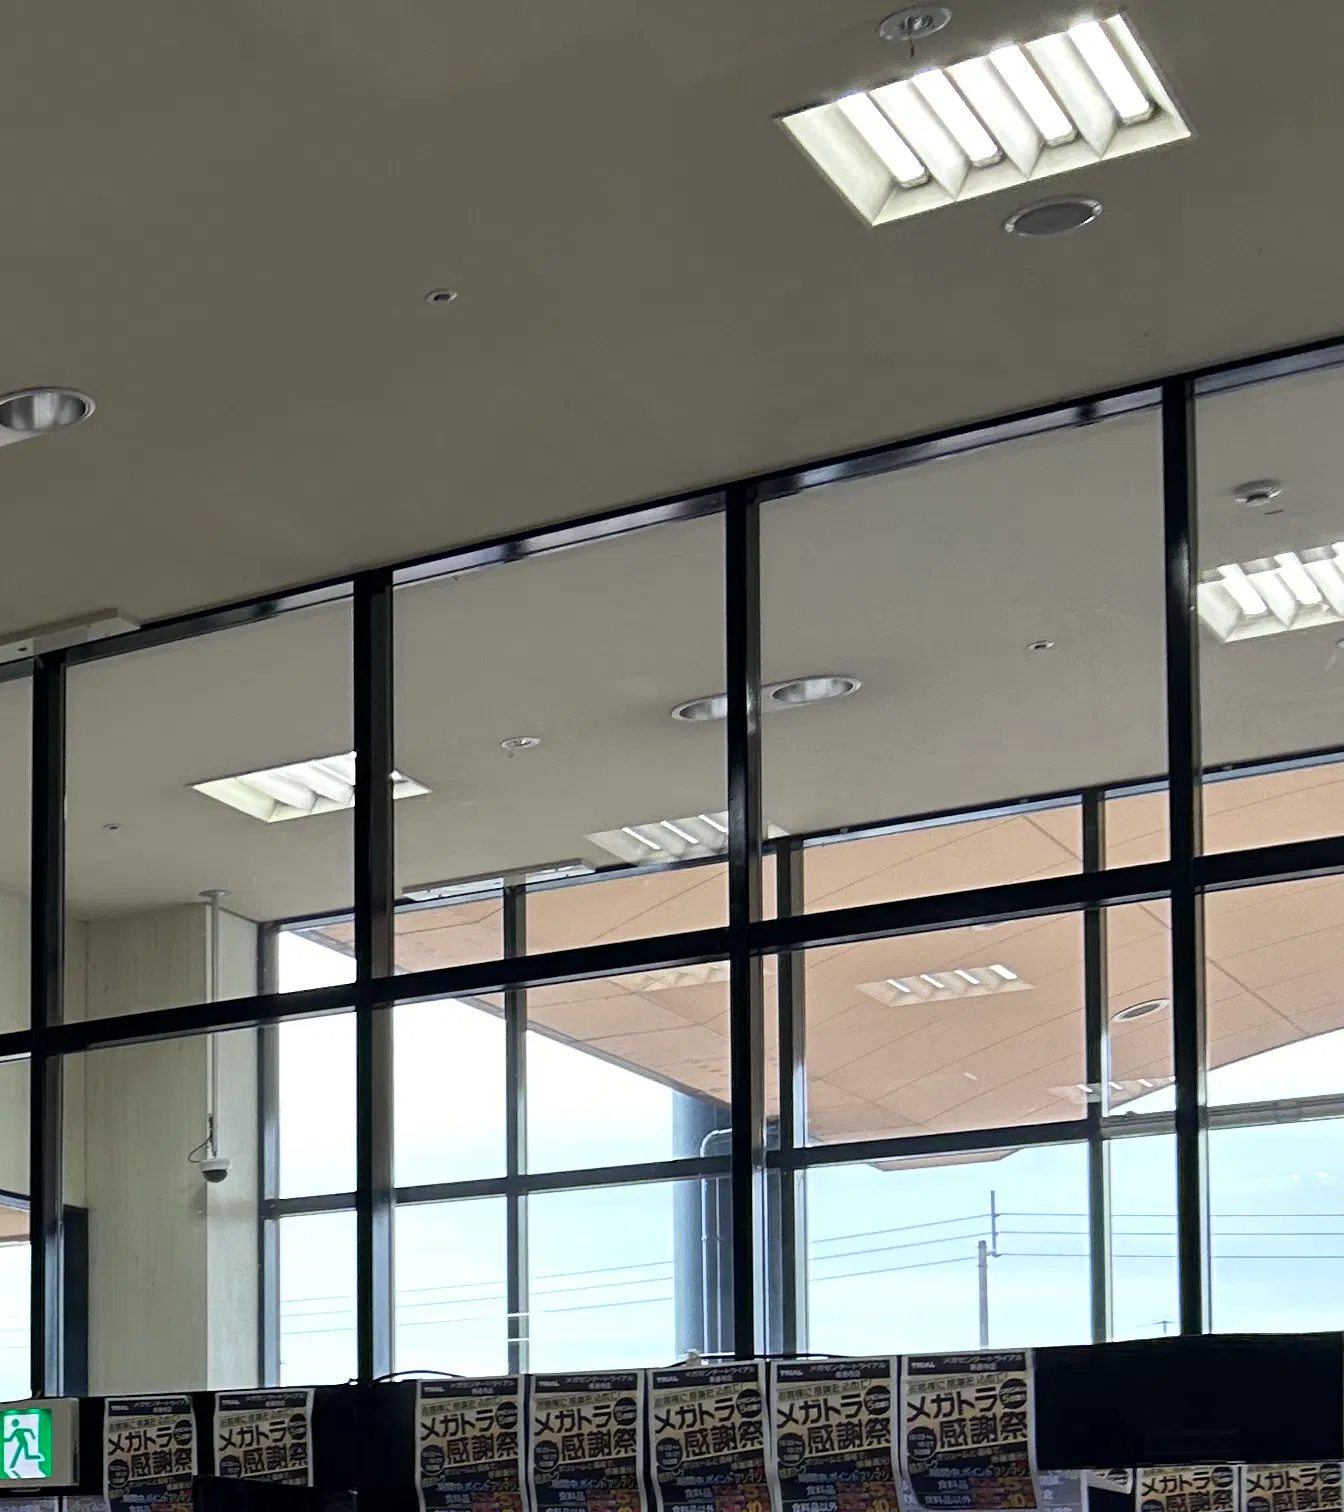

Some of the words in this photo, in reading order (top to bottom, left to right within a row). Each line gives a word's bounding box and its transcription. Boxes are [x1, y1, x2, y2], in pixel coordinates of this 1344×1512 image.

[655, 1397, 735, 1434] メガトラ
[777, 1393, 862, 1428] メガトラ
[907, 1386, 998, 1422] メガトラ
[219, 1420, 287, 1451] メガトラ
[421, 1408, 494, 1441] メガトラ
[534, 1405, 612, 1437] メガトラ
[807, 1417, 891, 1454] 感謝祭
[940, 1411, 1027, 1449] 感謝祭
[108, 1426, 173, 1455] メガトラ
[447, 1432, 518, 1465] 感謝祭
[562, 1428, 637, 1461] 感謝祭
[684, 1421, 764, 1457] 感謝祭
[131, 1447, 192, 1477] 感謝祭
[243, 1442, 308, 1474] 感謝祭
[1142, 1471, 1210, 1497] メガトラ
[1247, 1468, 1318, 1493] メガトラ
[1272, 1486, 1342, 1512] 感謝祭
